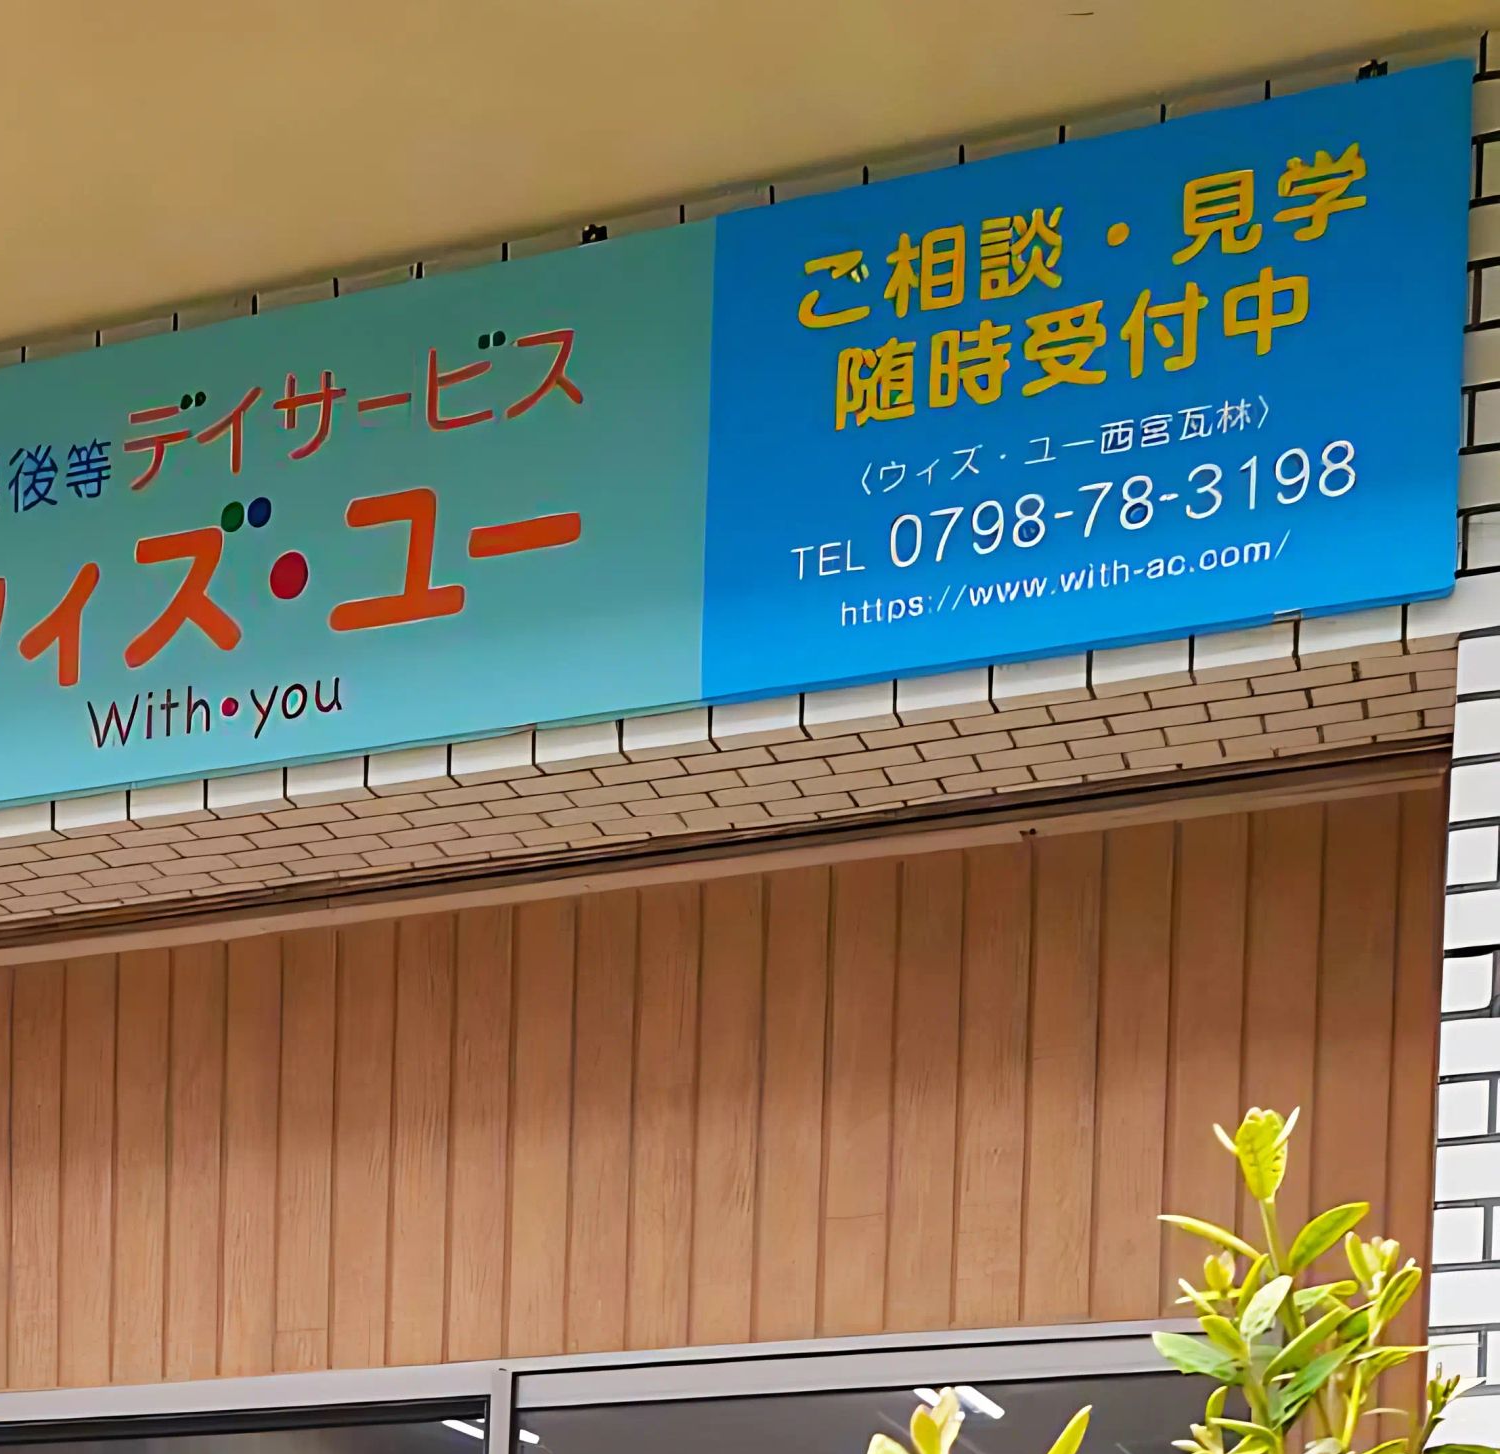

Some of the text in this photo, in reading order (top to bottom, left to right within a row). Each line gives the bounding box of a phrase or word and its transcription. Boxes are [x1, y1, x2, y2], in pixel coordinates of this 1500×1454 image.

[798, 142, 1368, 330] ご相談・見学
[834, 266, 1310, 431] 随時受付中
[791, 439, 1357, 581] TEL 0798-78-3198
